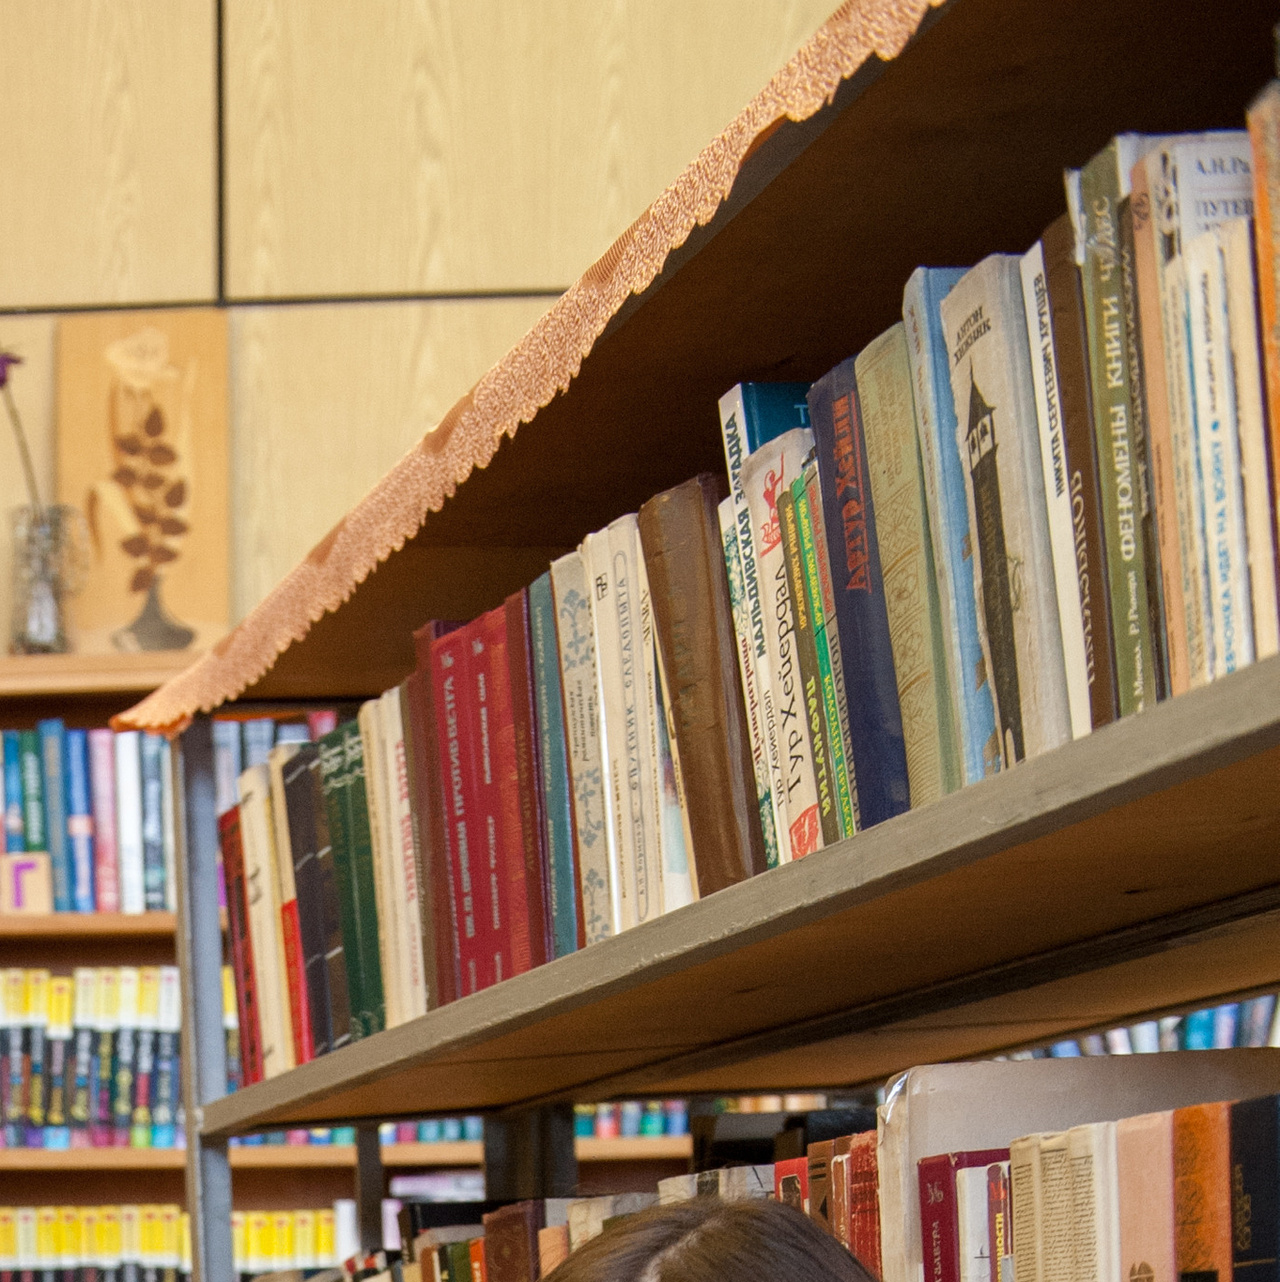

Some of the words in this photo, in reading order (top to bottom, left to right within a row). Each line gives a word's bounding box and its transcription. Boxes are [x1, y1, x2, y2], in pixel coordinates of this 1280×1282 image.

[1033, 272, 1050, 342] ХРУЩЕВ
[1100, 294, 1125, 388] КНИГИ
[1040, 342, 1060, 432] СЕРГЕЕВИЧ
[725, 412, 746, 505] ЗАГАДКА
[831, 394, 856, 497] Хейли
[1047, 432, 1066, 498] НИКИТА
[1109, 404, 1137, 562] ФЕНОМЕНЫ
[736, 508, 768, 656] МАЛЬДИВСКАЯ
[840, 498, 868, 591] Артур
[773, 562, 798, 729] Хейердал
[443, 674, 458, 739] ВЕТРА
[806, 676, 832, 817] ПАФНУТИЙ
[447, 739, 465, 816] ПРОТИВ
[782, 729, 805, 803] Тур
